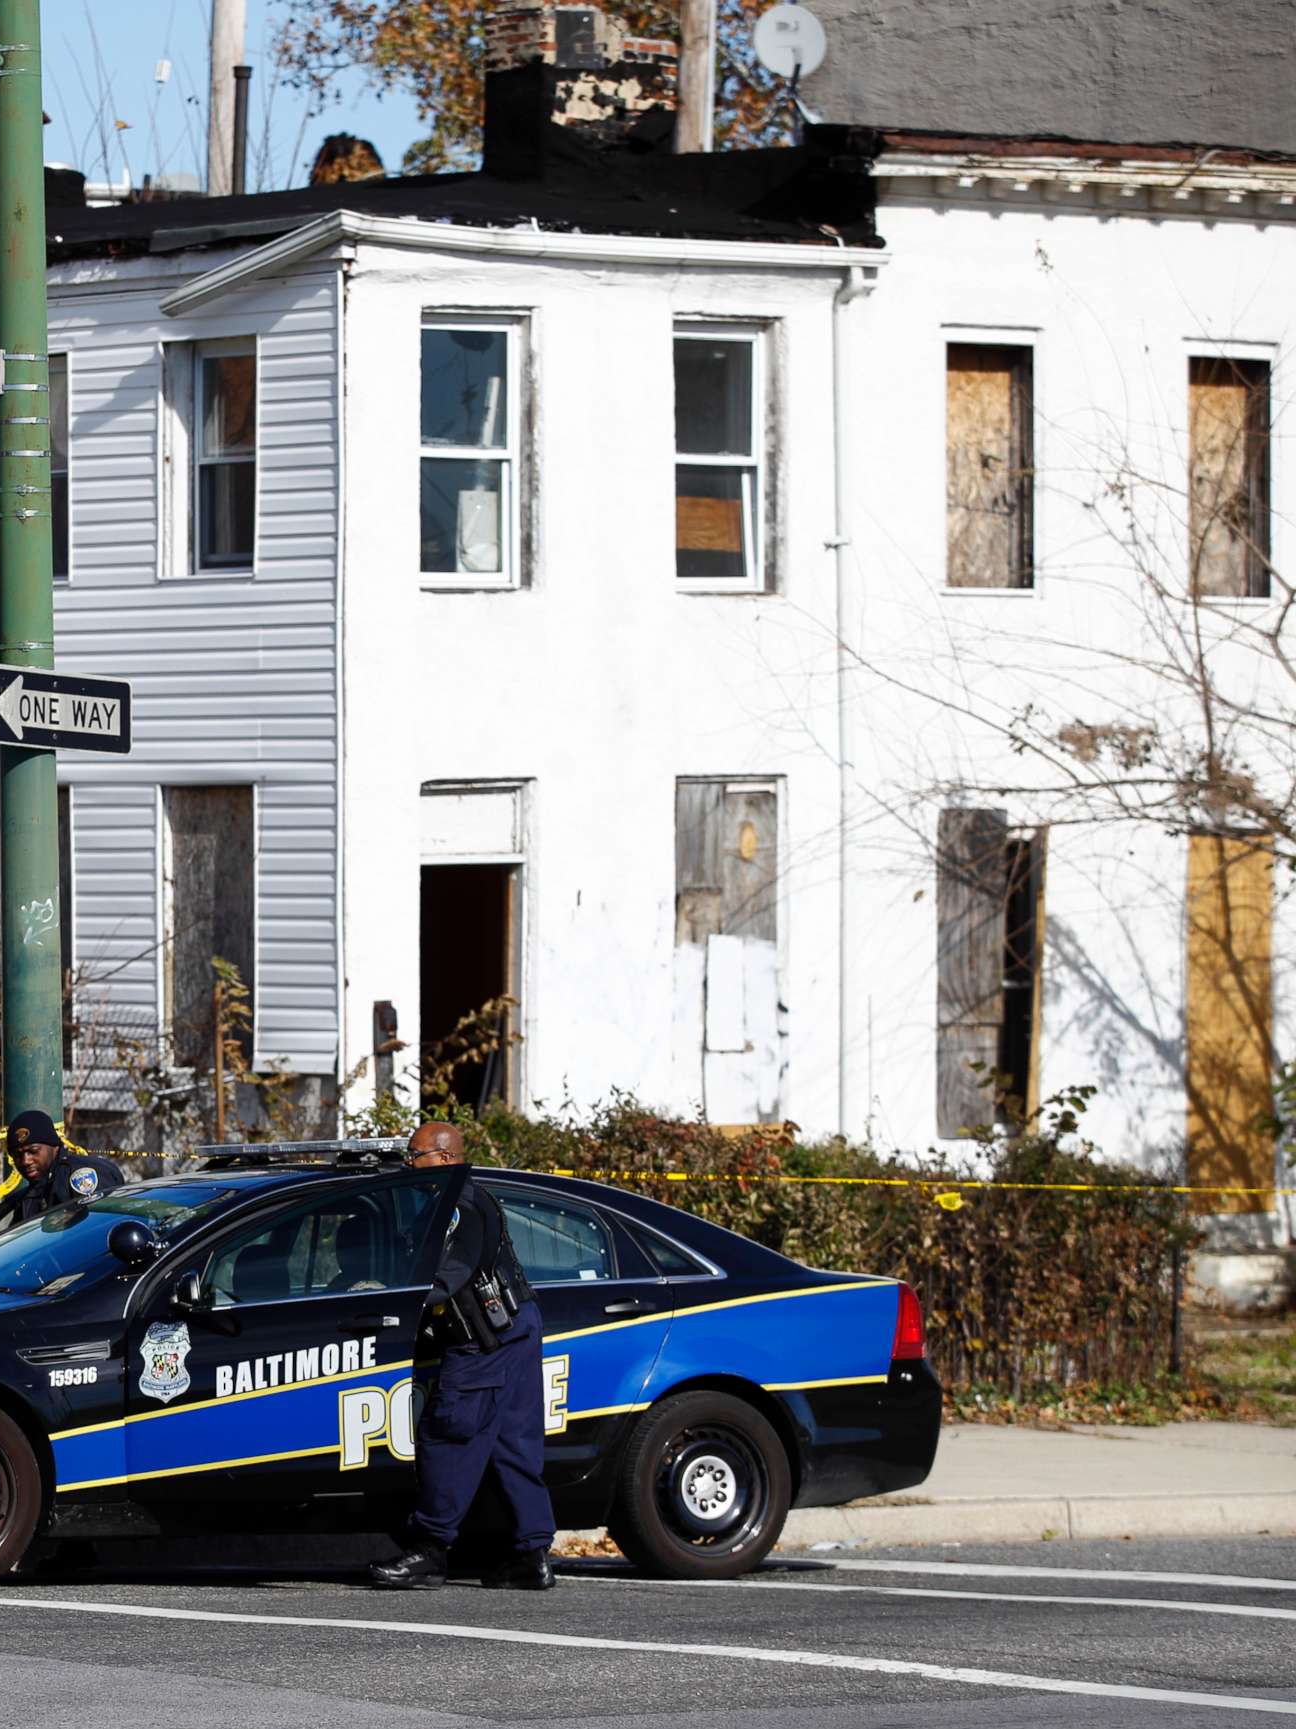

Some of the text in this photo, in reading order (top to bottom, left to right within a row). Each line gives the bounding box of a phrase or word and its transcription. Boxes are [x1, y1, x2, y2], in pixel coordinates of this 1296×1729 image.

[19, 694, 117, 730] ONE WAY
[48, 1366, 98, 1388] 159316
[215, 1335, 378, 1398] BALTIMORE
